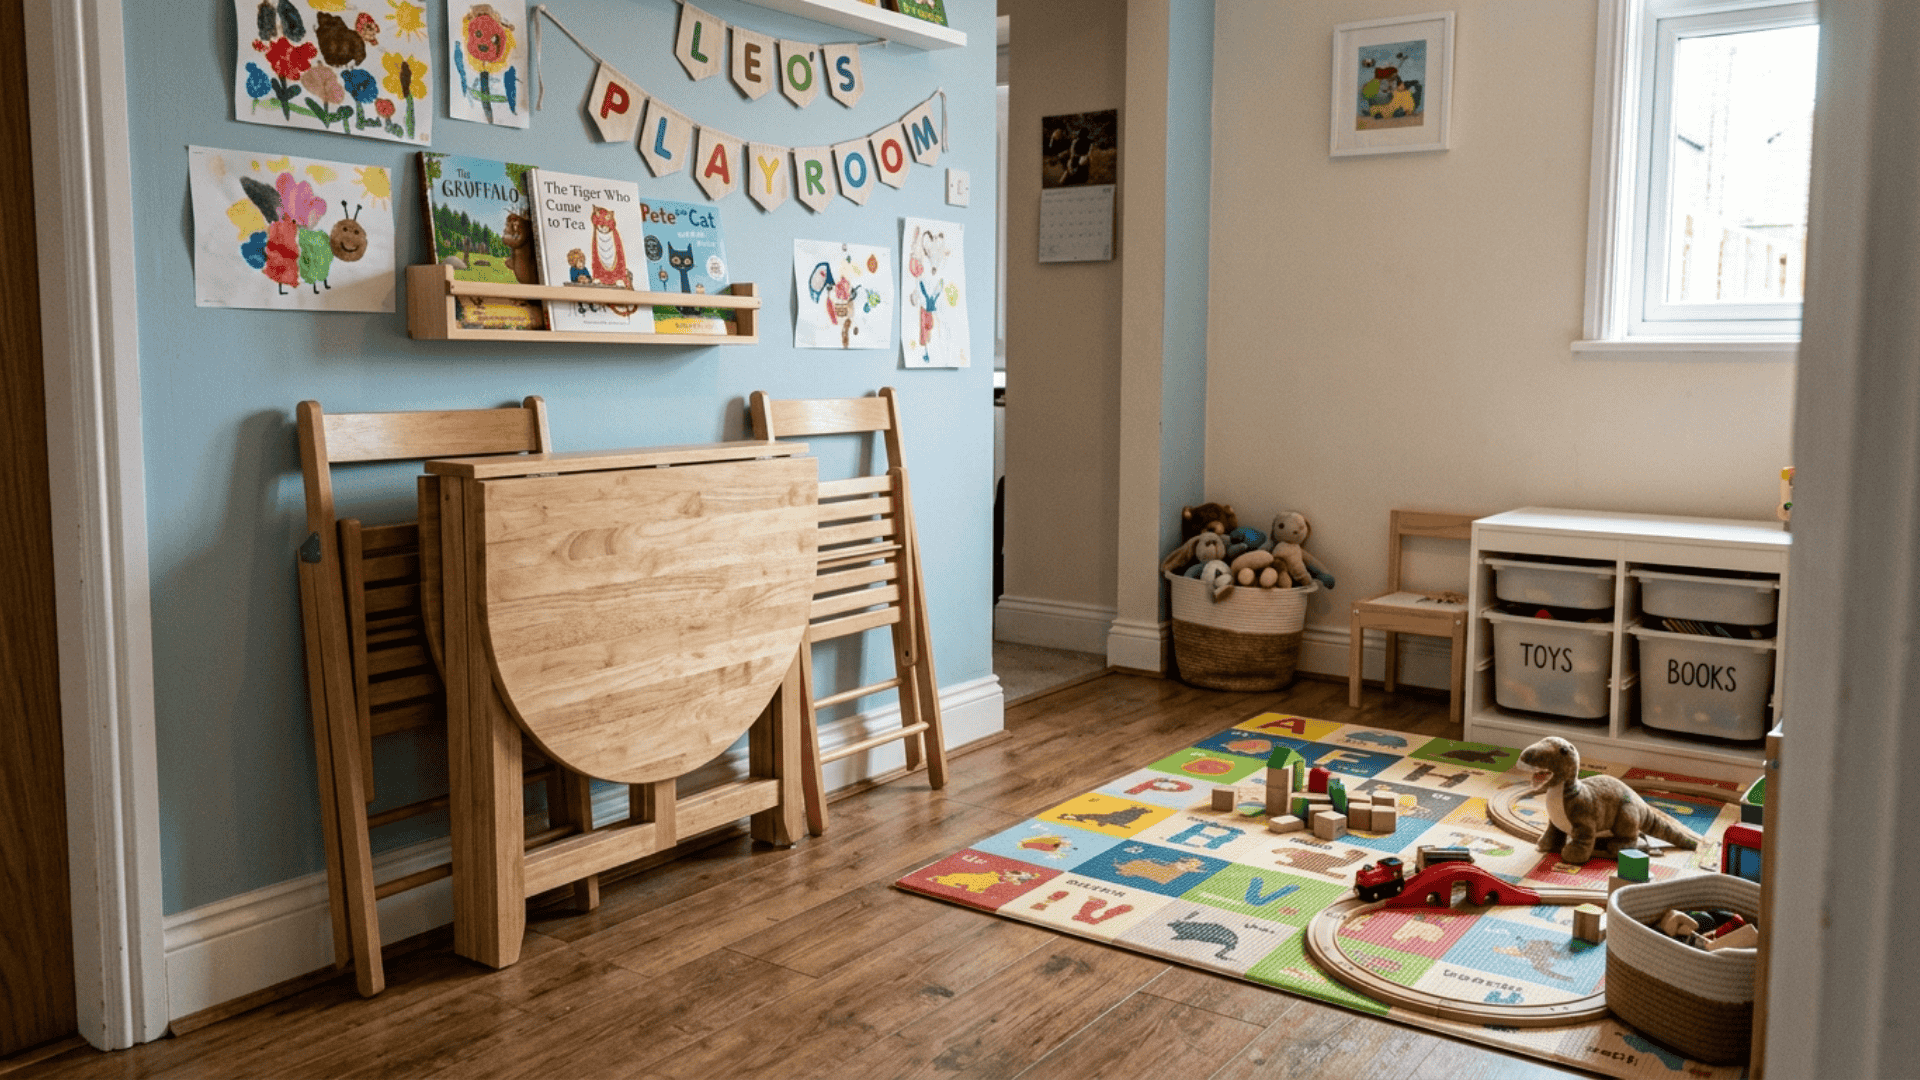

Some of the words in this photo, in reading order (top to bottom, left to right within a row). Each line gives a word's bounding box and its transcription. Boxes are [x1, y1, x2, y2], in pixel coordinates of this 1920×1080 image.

[690, 21, 855, 92] LEO'S
[600, 81, 939, 196] PLAYROOM
[442, 179, 519, 204] GRUFFALO
[544, 181, 568, 195] The
[570, 184, 601, 201] Tiger
[604, 189, 630, 203] Who
[547, 217, 560, 228] to
[562, 217, 586, 230] Tea
[640, 203, 676, 225] Pete
[688, 208, 716, 229] Cat
[1520, 642, 1573, 673] TOYS
[1667, 659, 1737, 692] BOOKS
